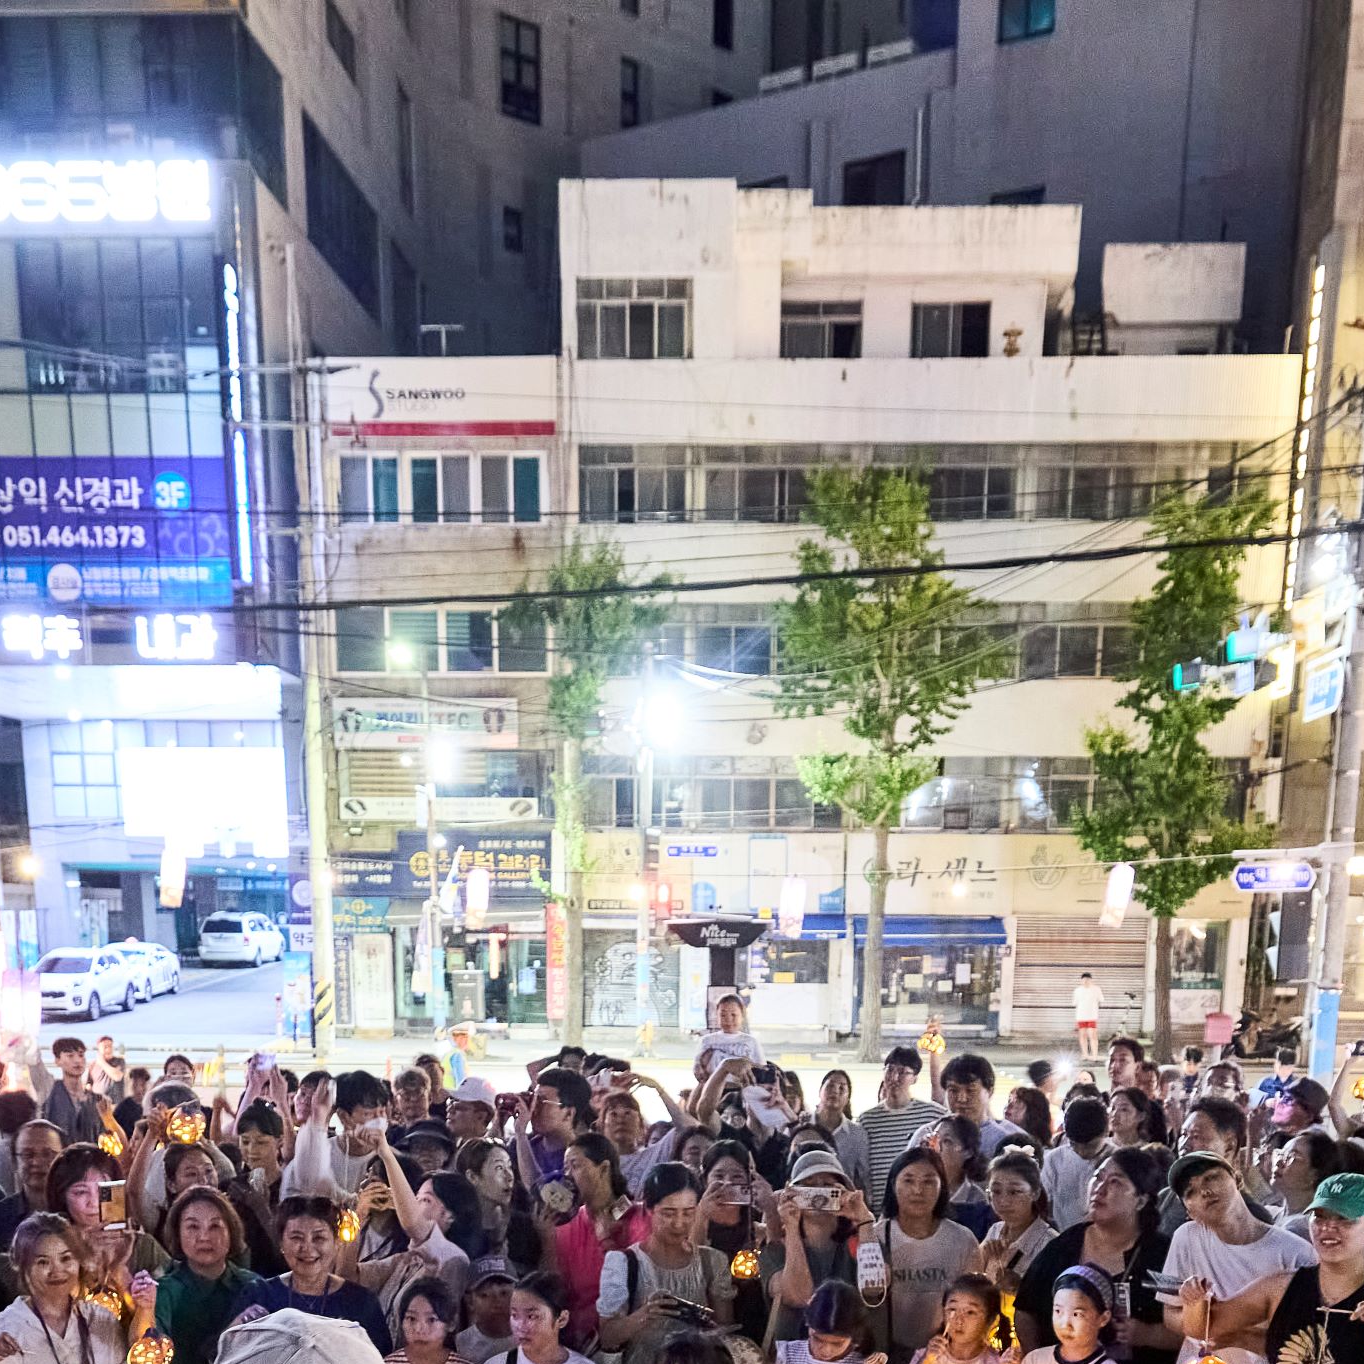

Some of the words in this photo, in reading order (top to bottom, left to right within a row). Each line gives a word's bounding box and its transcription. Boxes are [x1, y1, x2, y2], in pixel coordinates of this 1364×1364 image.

[386, 387, 465, 400] SANGWOO
[54, 477, 143, 512] 신경과
[155, 481, 185, 506] 3F
[136, 613, 218, 660] 내과
[701, 926, 727, 938] Nice
[894, 1268, 947, 1282] SHASTA
